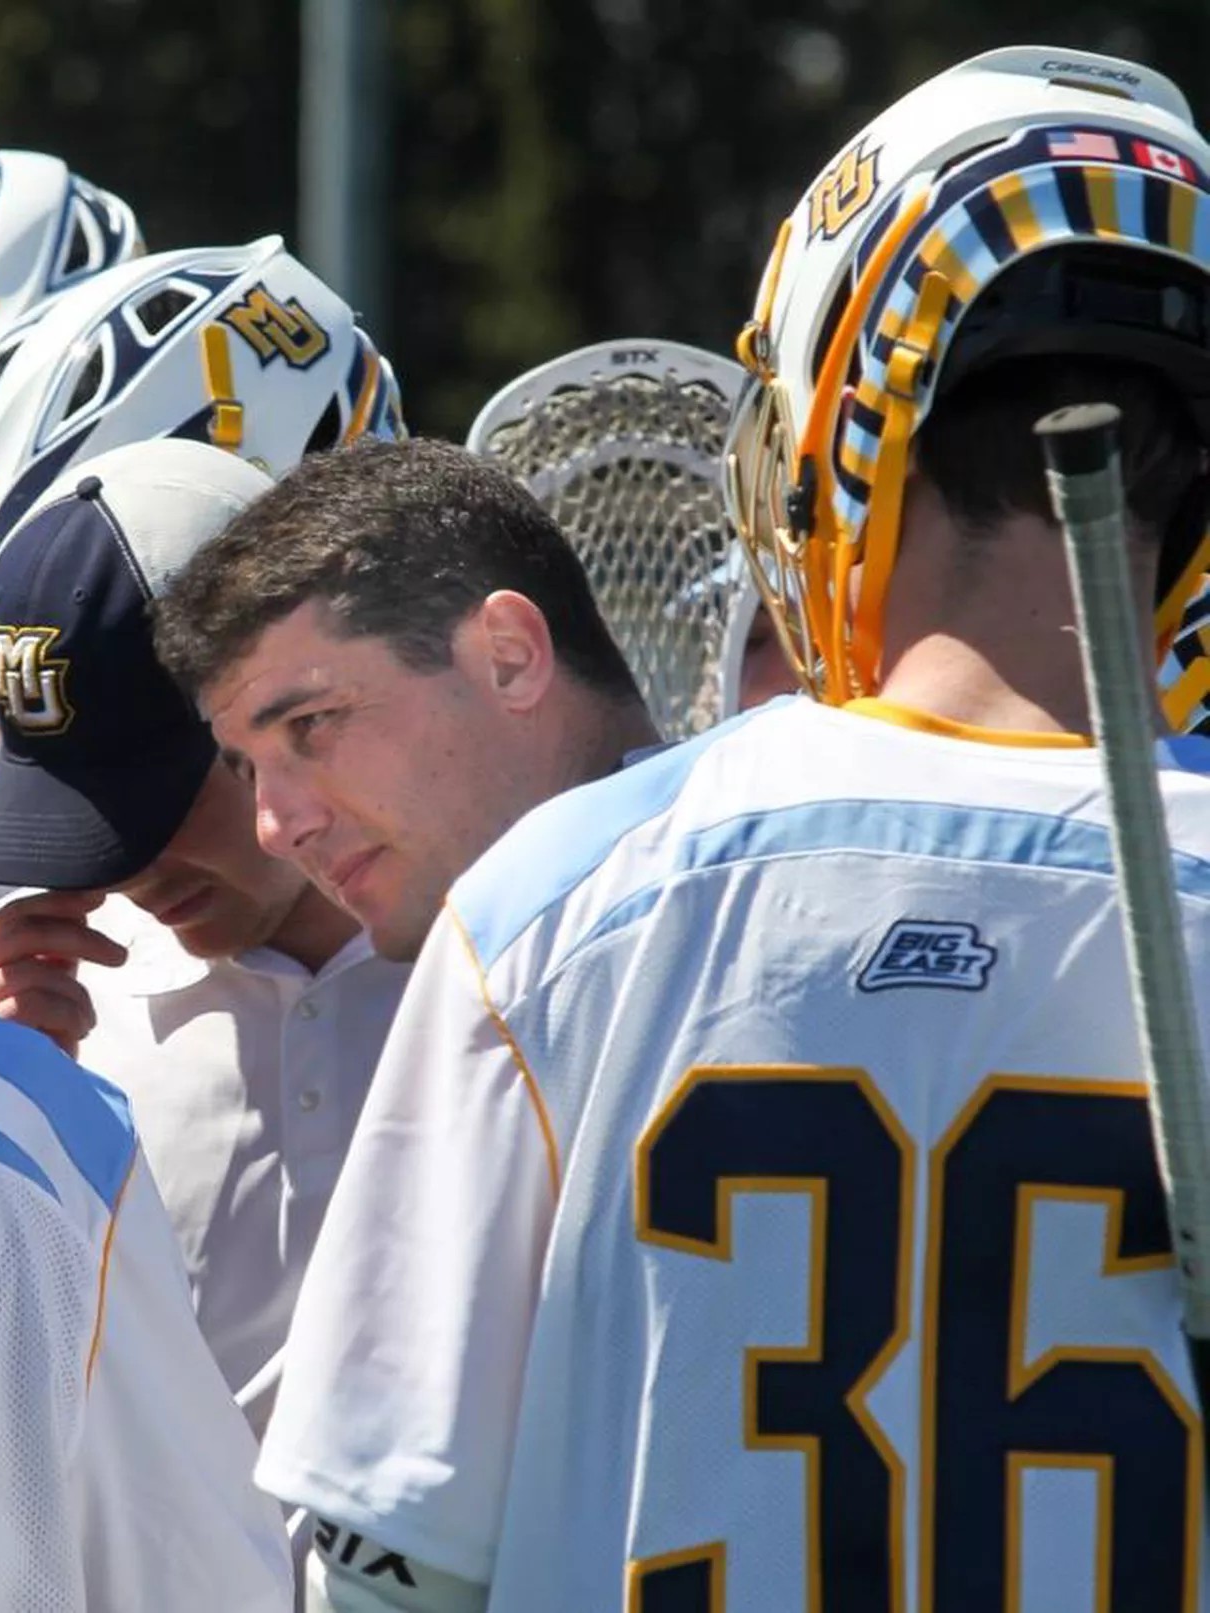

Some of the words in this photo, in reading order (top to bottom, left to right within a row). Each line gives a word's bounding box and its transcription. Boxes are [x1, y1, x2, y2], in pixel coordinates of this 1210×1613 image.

[1041, 60, 1141, 86] cascade
[214, 280, 331, 371] MU
[611, 349, 659, 366] STX
[892, 931, 965, 952] BIG
[879, 951, 983, 973] EAST
[626, 1063, 1206, 1613] 36
